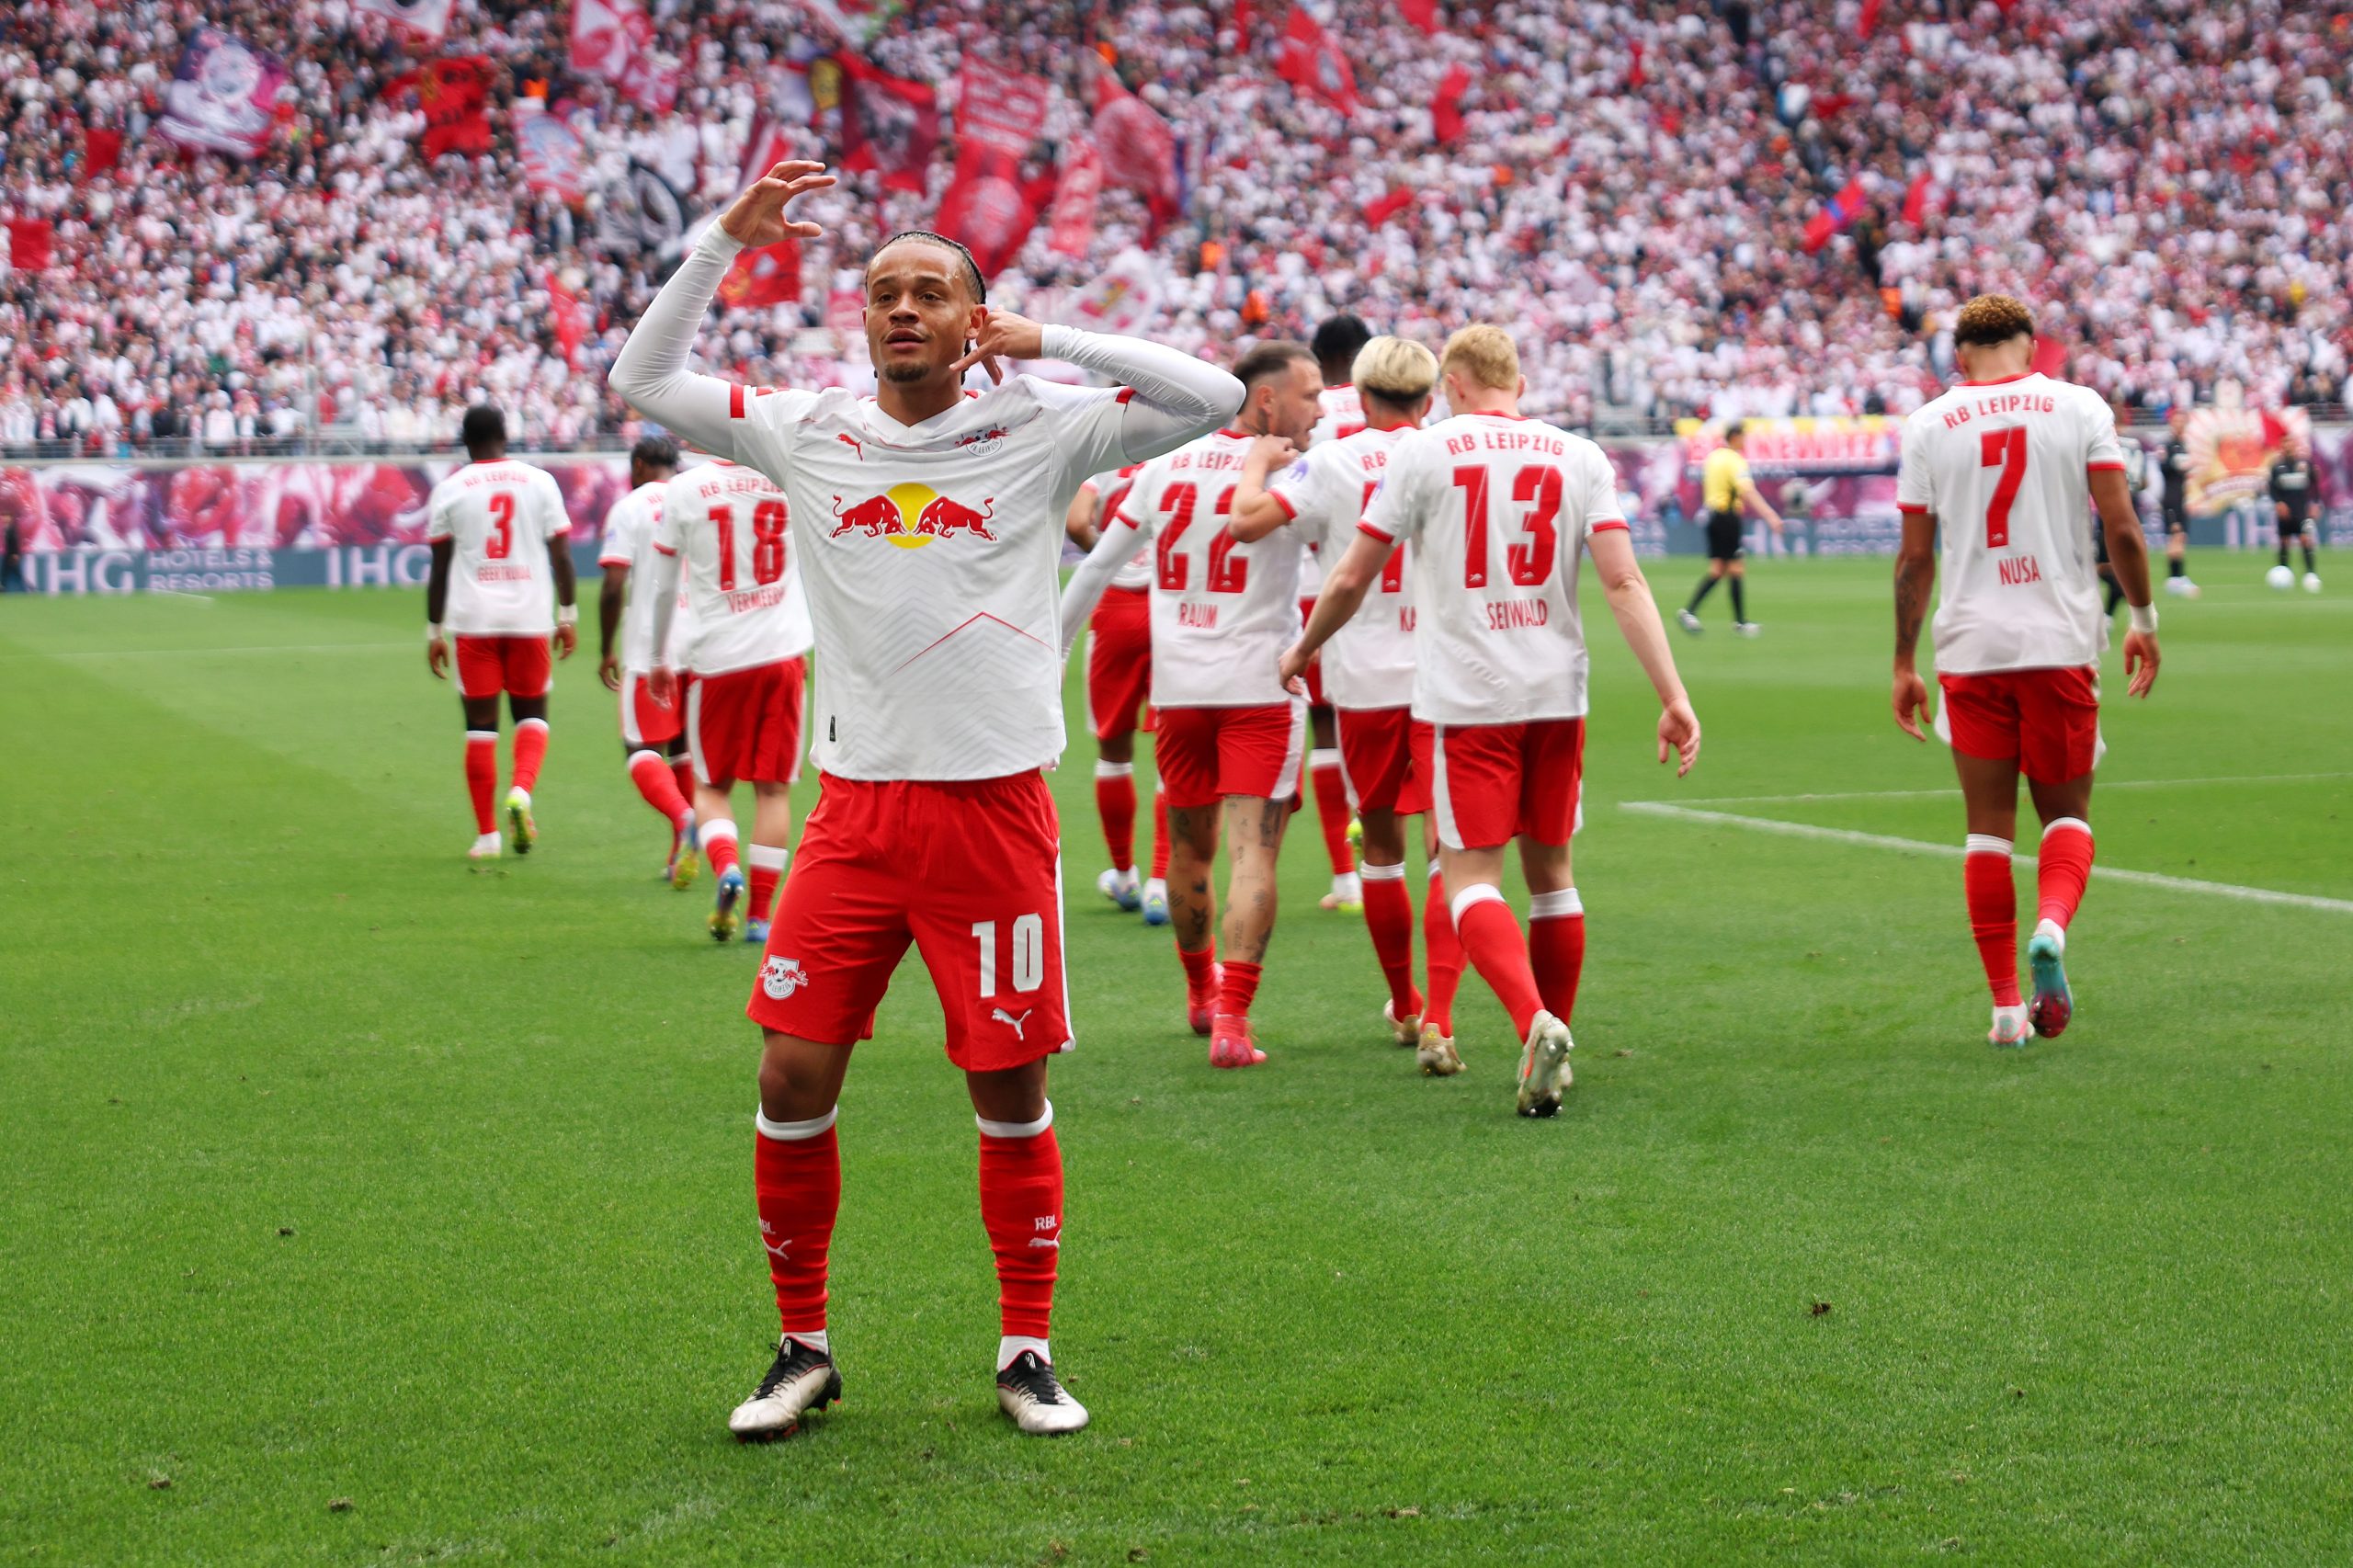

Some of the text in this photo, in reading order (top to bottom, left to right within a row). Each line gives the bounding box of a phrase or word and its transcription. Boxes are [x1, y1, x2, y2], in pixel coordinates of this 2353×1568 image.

[1943, 393, 2054, 428] RB LEIPZIG
[1446, 431, 1565, 456] RB LEIPZIG
[1171, 452, 1192, 471] RB
[1361, 450, 1387, 472] RB
[699, 481, 721, 497] RB
[1981, 425, 2028, 549] 7
[486, 491, 515, 559] 3
[1157, 482, 1248, 593] 22
[1453, 463, 1563, 589] 13
[708, 500, 788, 591] 18
[23, 549, 274, 592] IHG HOTELS &
[149, 572, 274, 591] RESORTS
[1998, 555, 2041, 585] NUSA
[1177, 603, 1218, 630] RAUM
[1400, 606, 1416, 631] KA
[1485, 598, 1548, 631] SEIWALD
[972, 912, 1043, 998] 10
[759, 1215, 777, 1235] BL
[1034, 1214, 1058, 1231] RBL
